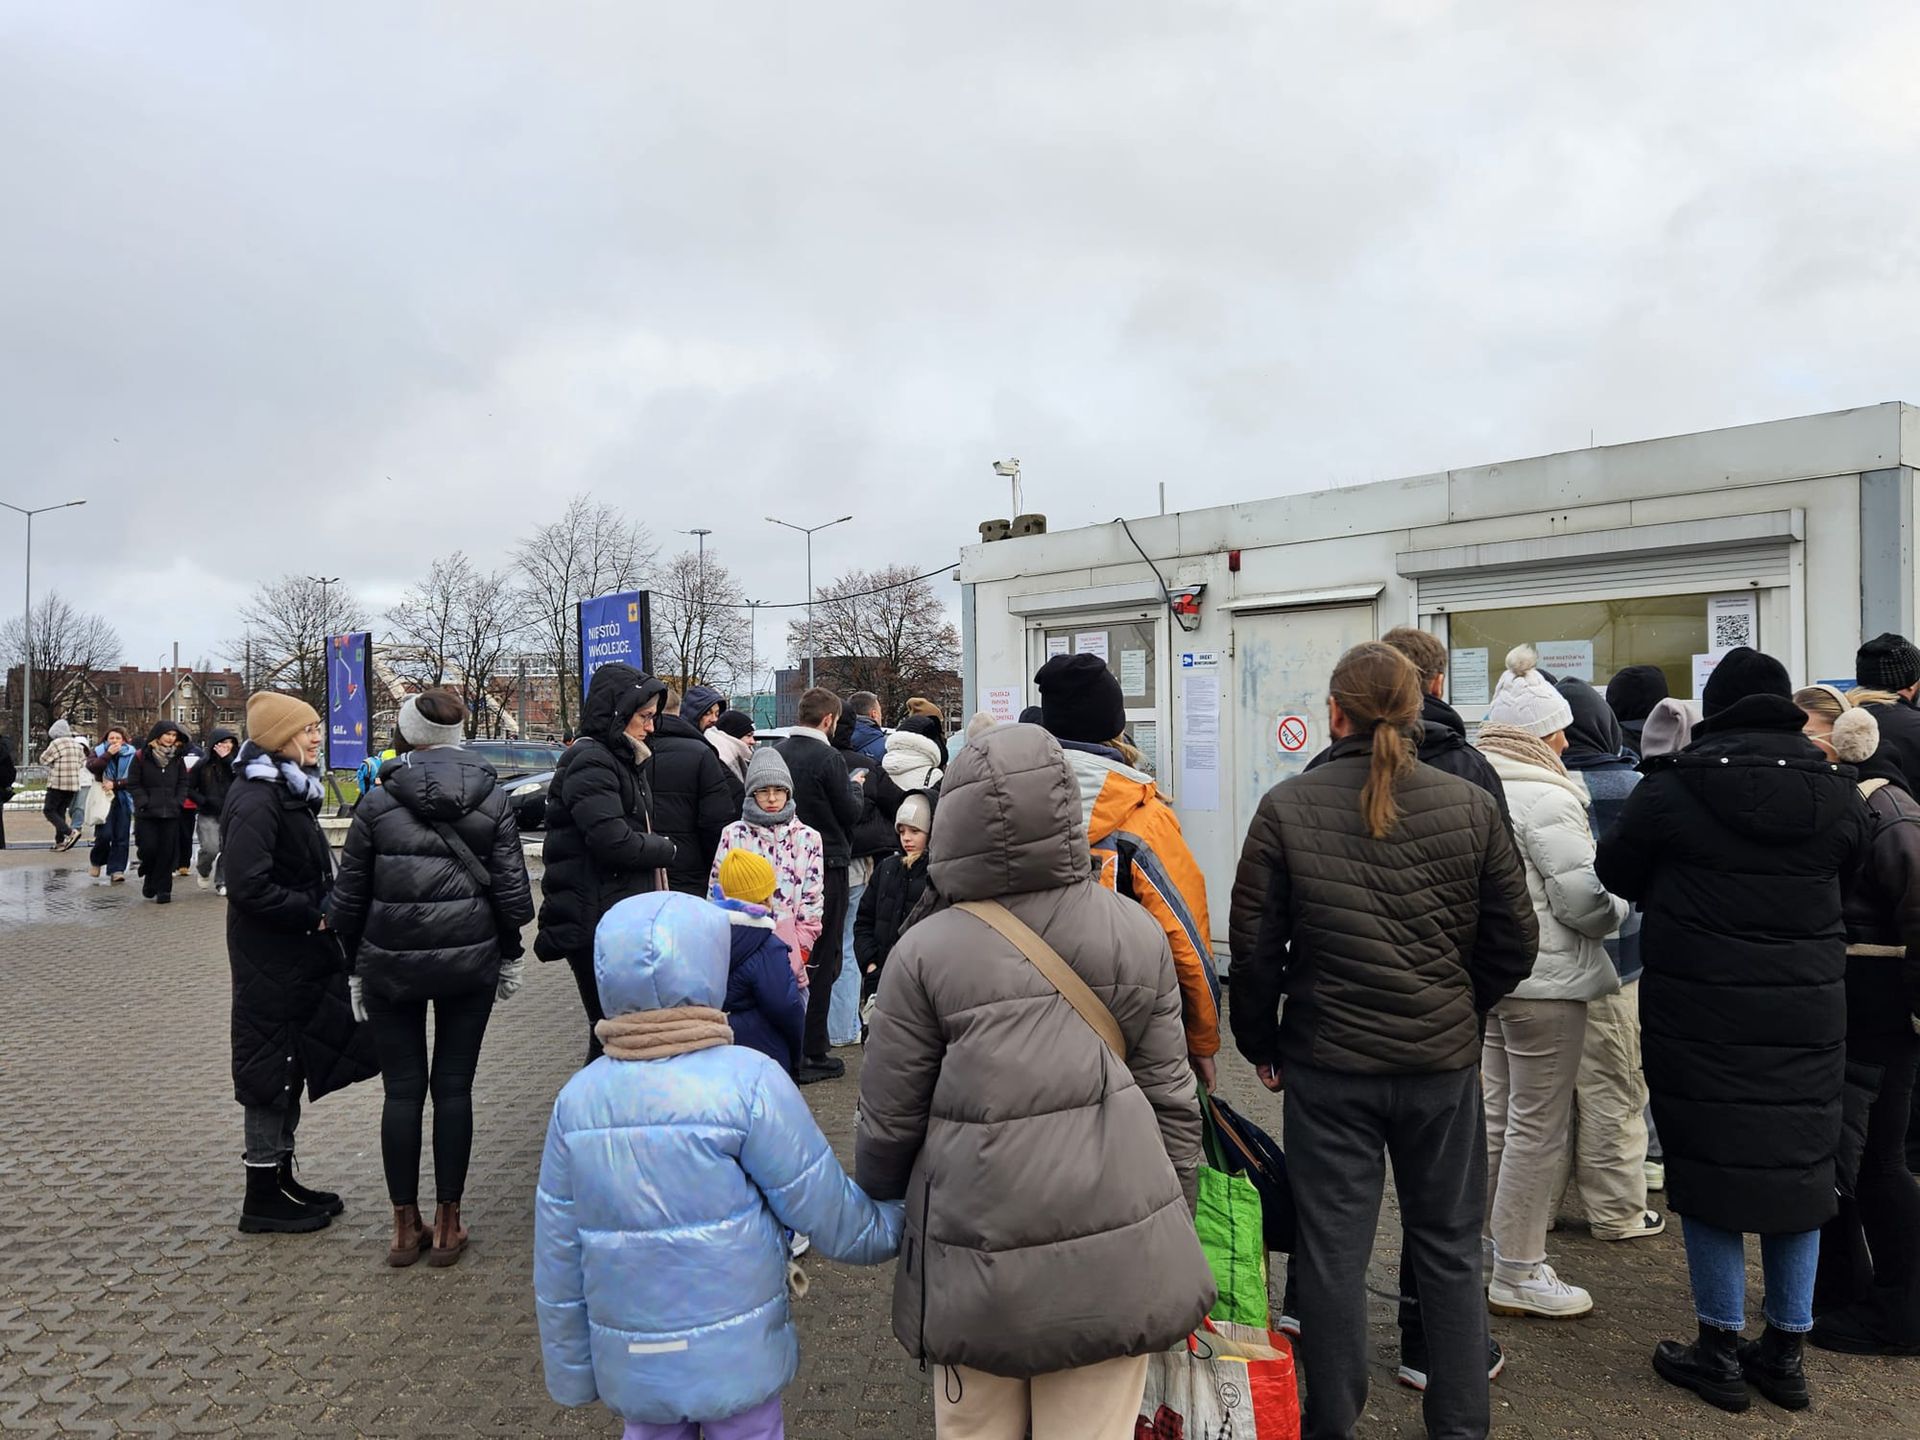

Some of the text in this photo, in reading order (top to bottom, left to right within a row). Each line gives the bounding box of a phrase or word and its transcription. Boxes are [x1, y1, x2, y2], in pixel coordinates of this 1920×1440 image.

[588, 620, 620, 641] NIE STÓJ
[588, 640, 632, 658] W KOLEJCE.
